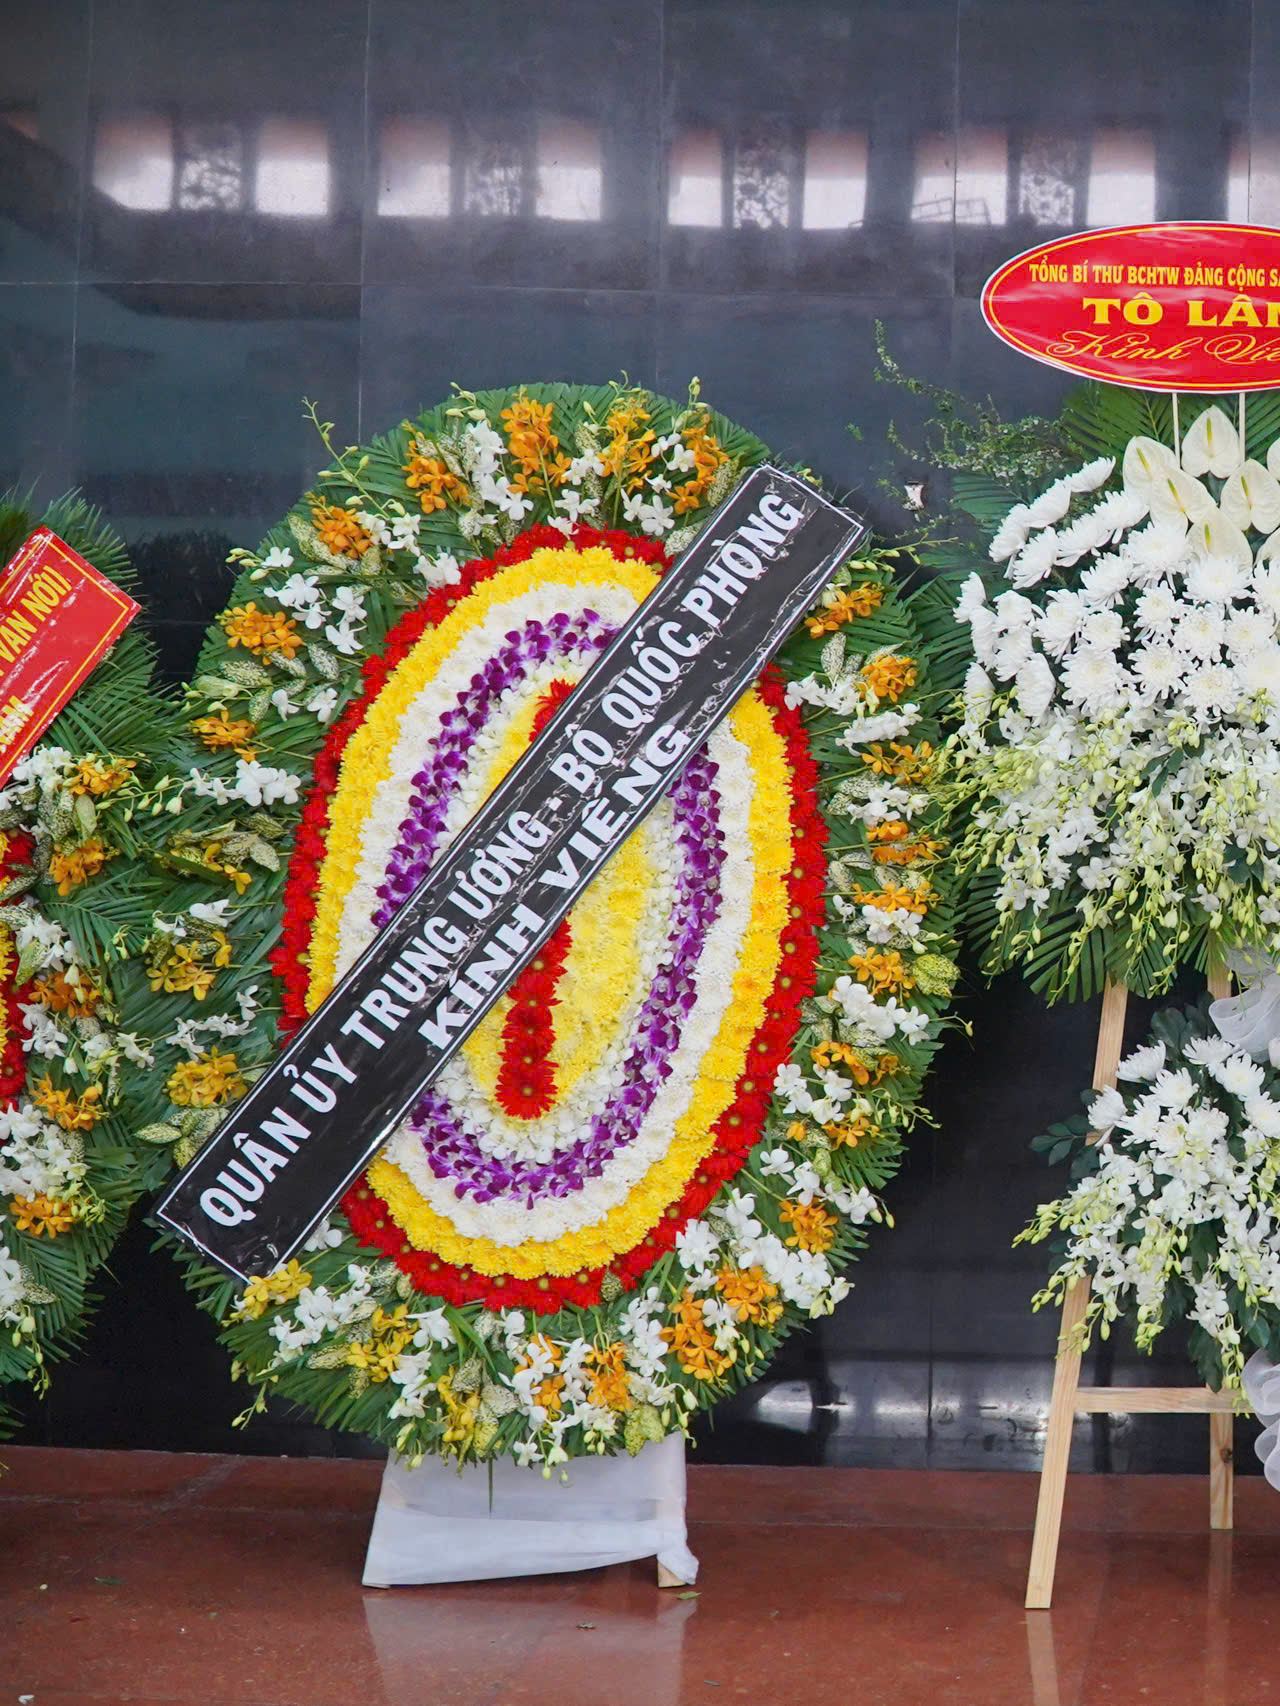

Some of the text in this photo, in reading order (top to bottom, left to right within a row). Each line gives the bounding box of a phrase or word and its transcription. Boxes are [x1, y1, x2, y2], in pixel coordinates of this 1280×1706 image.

[1029, 255, 1068, 283] TỔNG
[1073, 259, 1088, 283] BÍ
[1093, 264, 1124, 284] THƯ
[1127, 266, 1180, 285] BCHTW
[1184, 261, 1224, 286] ĐẢNG
[1228, 263, 1265, 292] CỘNG
[1082, 291, 1163, 326] TÔ
[1046, 330, 1203, 360] Kính
[199, 1106, 312, 1227] QUÂN
[282, 1043, 358, 1114] ỦY
[340, 916, 470, 1050] TRUNG
[448, 810, 554, 921] ƯƠNG
[550, 723, 626, 795] BỘ
[602, 620, 701, 730] QUỐC
[681, 494, 805, 629] PHÒNG
[418, 723, 691, 1050] KÍNH VIẾNG
